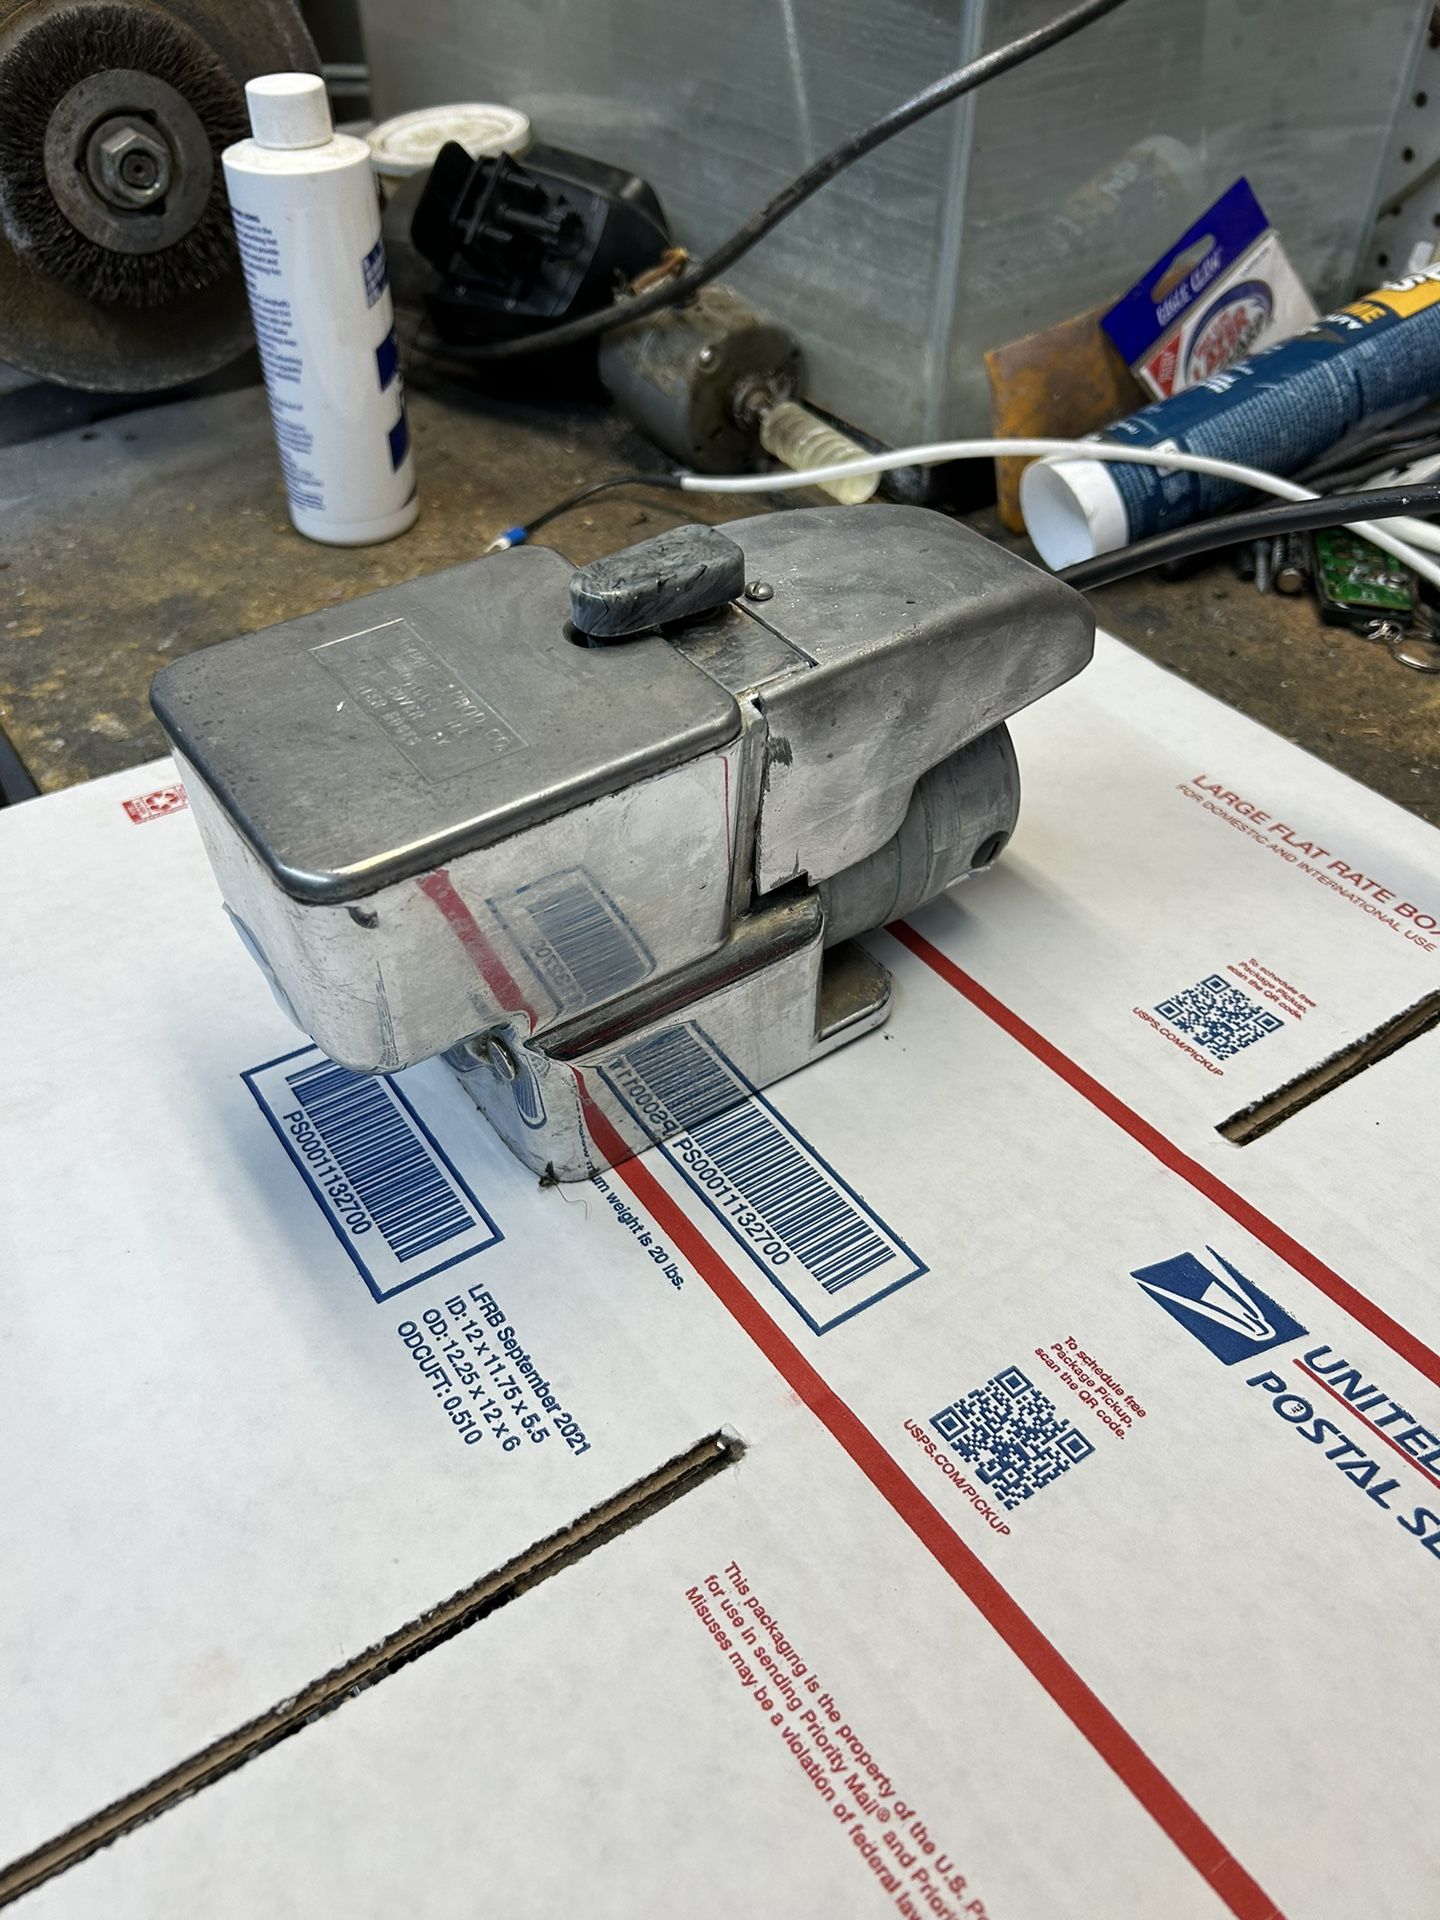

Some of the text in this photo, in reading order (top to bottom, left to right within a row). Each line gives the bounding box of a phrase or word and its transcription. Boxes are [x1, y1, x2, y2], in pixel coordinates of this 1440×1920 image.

[1176, 783, 1438, 953] FOR DOMESTIC AND INTERNATIONAL USE
[1192, 775, 1440, 934] LARGE FLAT RATE BO
[1132, 1006, 1225, 1077] USPS.COM/PICKUP
[283, 1110, 372, 1234] PS00011132700
[672, 1137, 790, 1265] PS00011132700
[606, 1192, 644, 1234] weight
[637, 1232, 652, 1246] is
[648, 1246, 669, 1264] 20
[662, 1263, 684, 1290] lbs.
[398, 1321, 482, 1444] ODCUFT: 0.510
[423, 1309, 521, 1451] OD: 12.25 x 12 x 6
[445, 1295, 550, 1443] ID: 12 x 11.75 x 5.5
[468, 1283, 591, 1455] LFRB September 2021
[1035, 1348, 1124, 1439] scan the QR code.
[1051, 1343, 1132, 1428] Package Pickup,
[1065, 1336, 1146, 1417] To schedule free
[904, 1419, 1010, 1535] USPS.COM/PICKUP
[1246, 1370, 1402, 1510] POSTAL
[686, 1587, 732, 1651] Misuses
[729, 1652, 758, 1686] may
[754, 1686, 773, 1711] be
[771, 1713, 783, 1726] a
[782, 1726, 835, 1801] violation
[833, 1803, 856, 1823] of
[849, 1824, 902, 1894] federal
[704, 1575, 725, 1597] for
[721, 1599, 744, 1627] use
[741, 1626, 756, 1645] in
[754, 1647, 803, 1712] sending
[800, 1709, 847, 1773] Priority
[883, 1831, 917, 1869] and
[725, 1561, 749, 1595] This
[744, 1597, 807, 1677] packaging
[804, 1675, 819, 1693] is
[817, 1694, 840, 1722] the
[835, 1724, 896, 1798] property
[894, 1801, 916, 1821] of
[910, 1821, 935, 1855] the
[934, 1855, 966, 1900] U.S.
